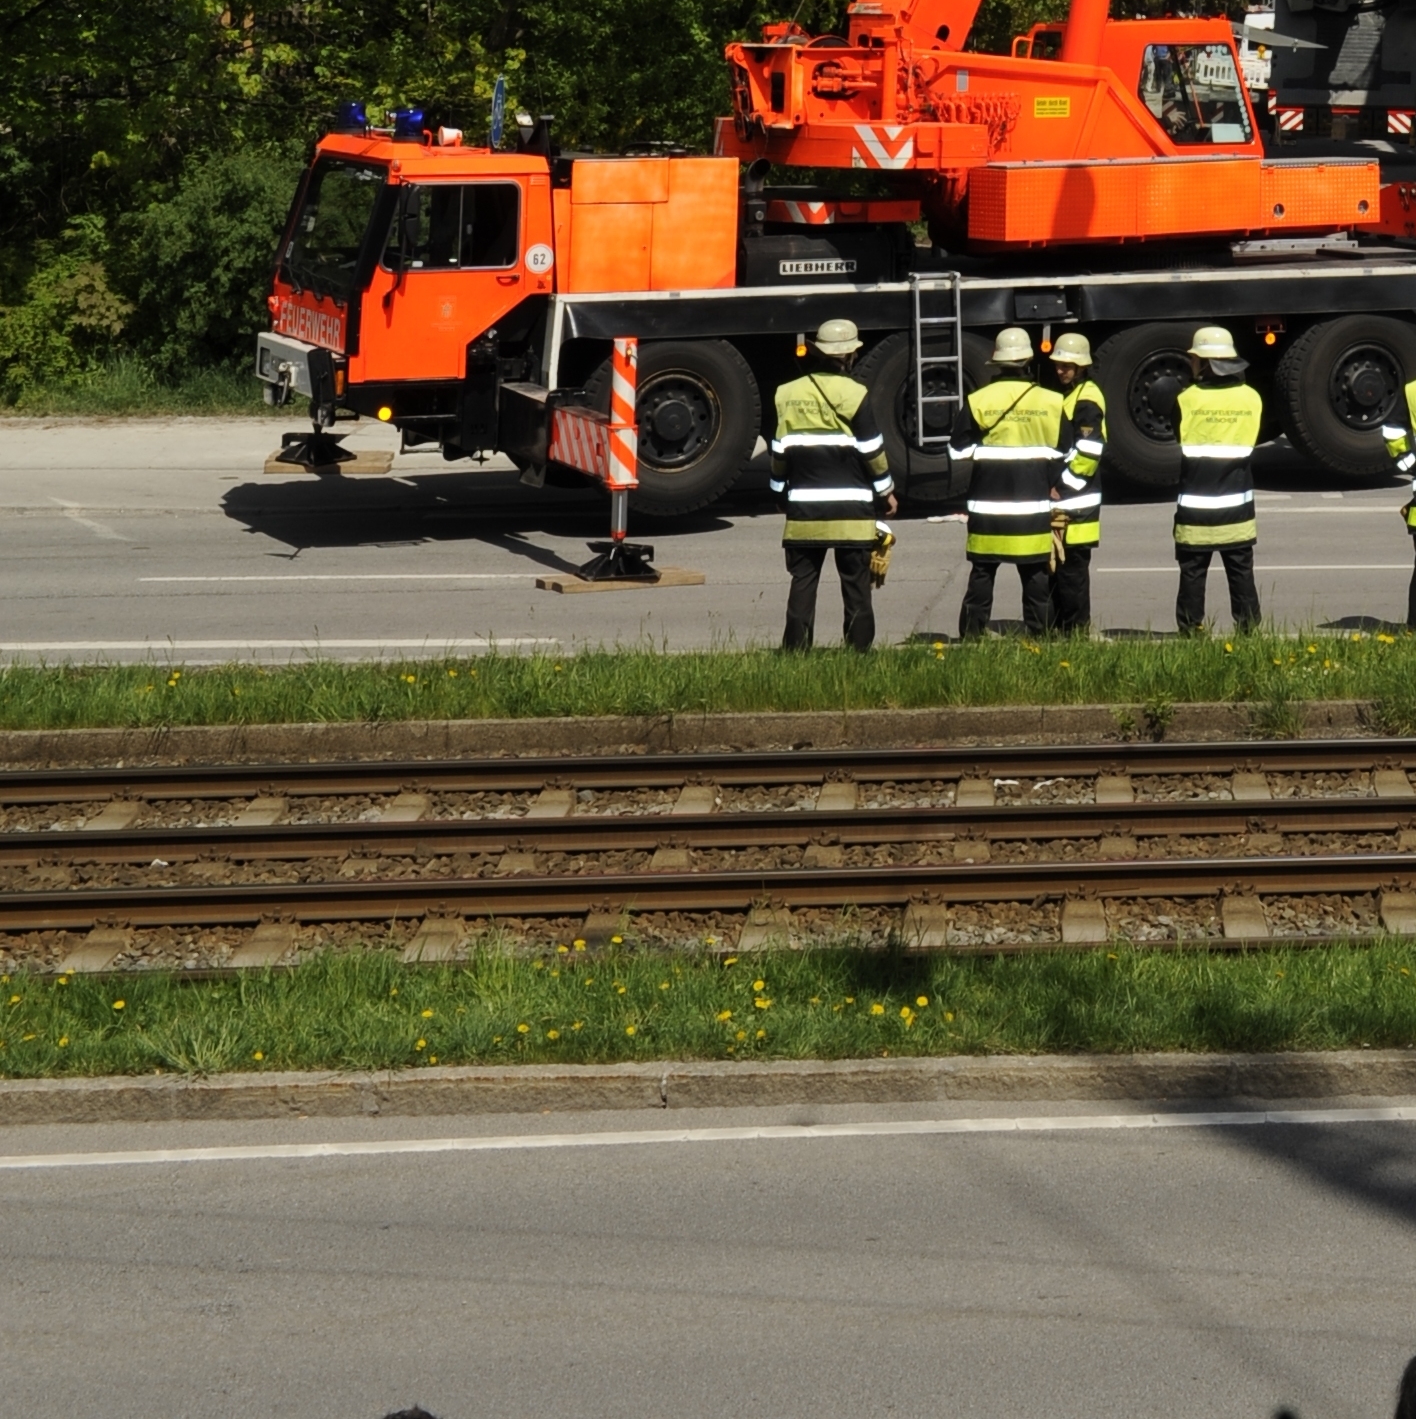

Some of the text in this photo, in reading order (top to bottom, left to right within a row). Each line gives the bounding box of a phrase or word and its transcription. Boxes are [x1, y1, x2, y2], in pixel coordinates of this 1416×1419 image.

[533, 253, 546, 265] 62
[782, 262, 855, 272] LIEBHERR
[280, 300, 340, 350] FEUERWEHR
